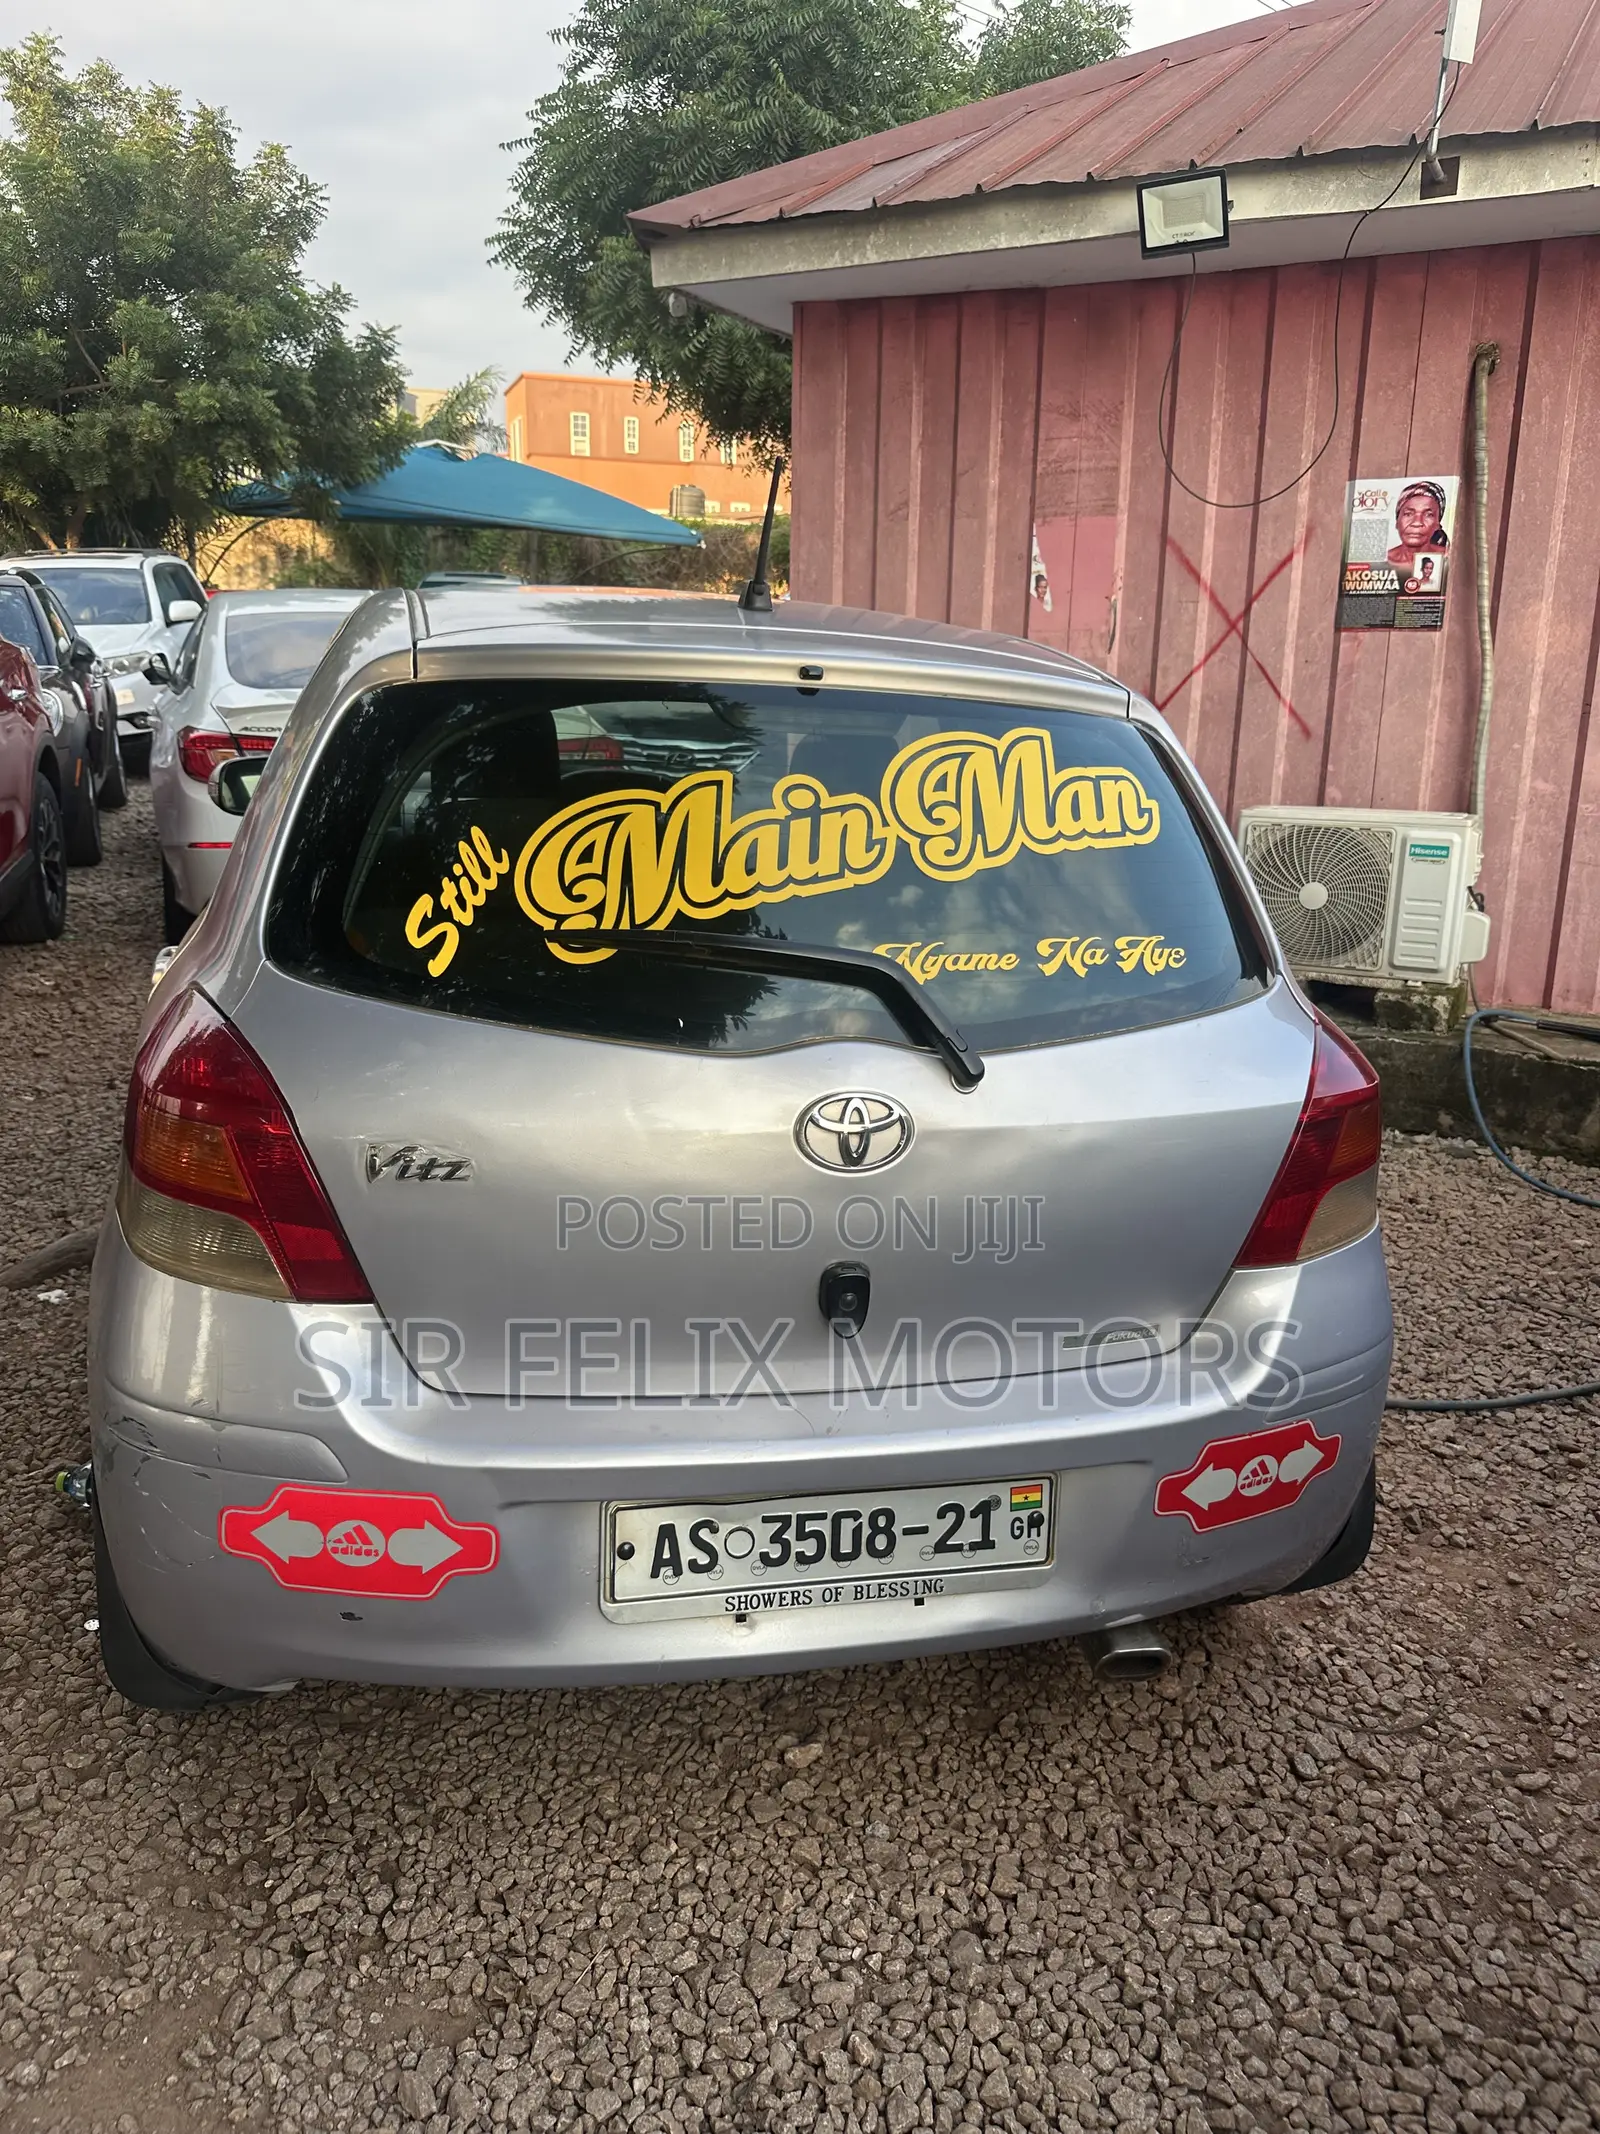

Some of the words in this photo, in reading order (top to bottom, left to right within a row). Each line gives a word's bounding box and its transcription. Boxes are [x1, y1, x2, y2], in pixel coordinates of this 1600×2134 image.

[1344, 569, 1398, 581] AKOSUA
[404, 825, 510, 978] Still
[514, 770, 896, 965] Main
[880, 726, 1160, 882] Man
[1410, 846, 1448, 857] Hisense
[872, 941, 1020, 985] Nyame
[1036, 936, 1109, 978] Na
[366, 1144, 473, 1184] Vitz
[1240, 1475, 1273, 1490] adidas
[330, 1545, 380, 1558] adidas
[650, 1518, 720, 1579] AS
[758, 1499, 997, 1568] 3508-21
[725, 1589, 813, 1612] SHOWERS
[822, 1587, 844, 1604] OF
[853, 1578, 945, 1601] BLESSING
